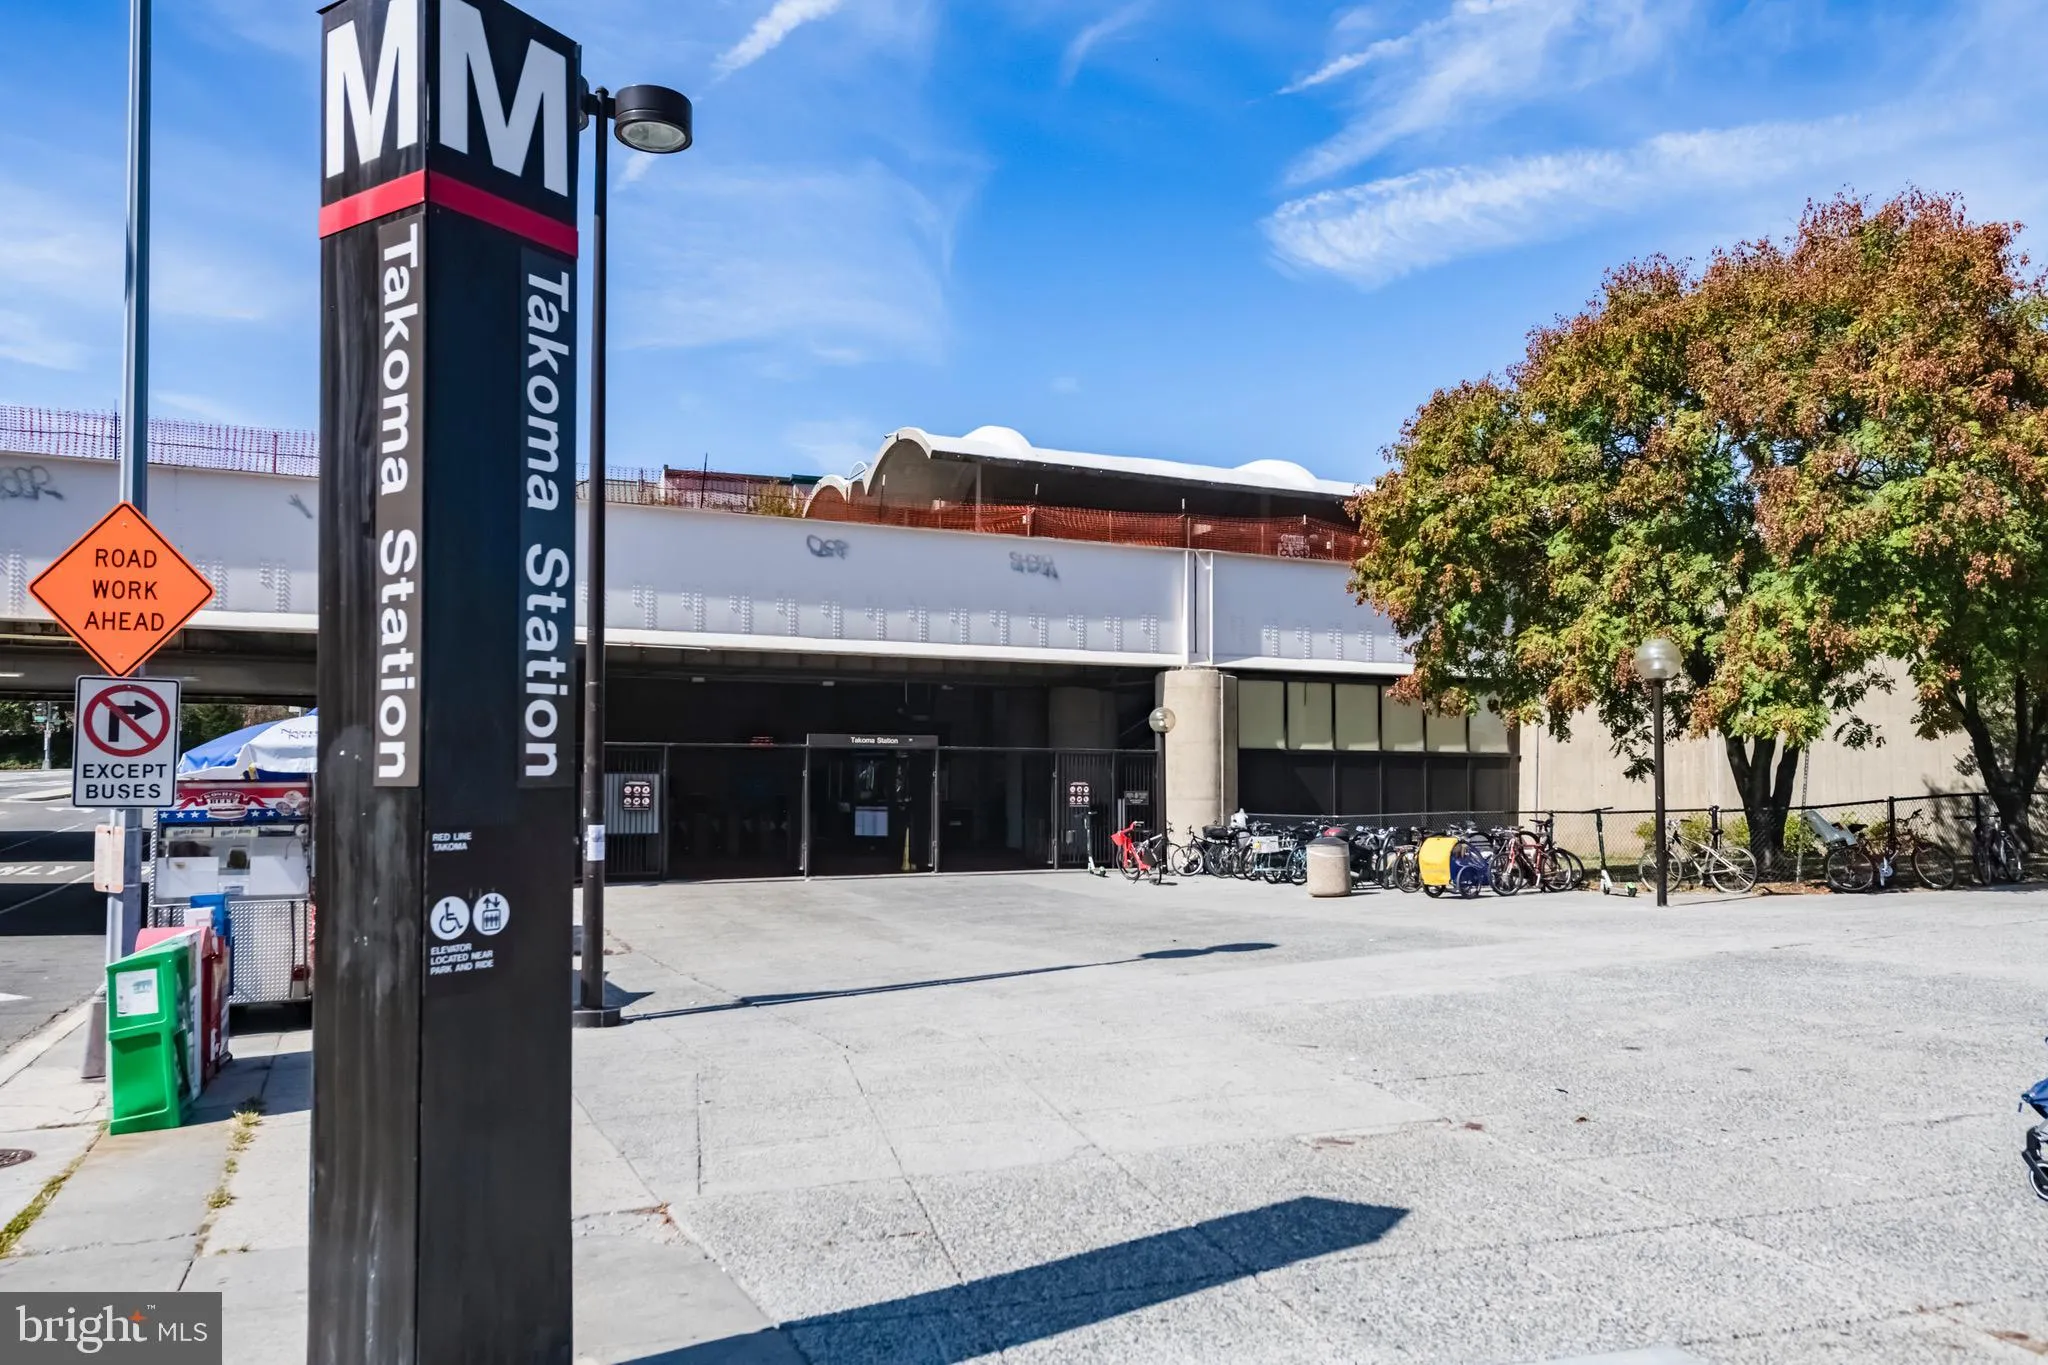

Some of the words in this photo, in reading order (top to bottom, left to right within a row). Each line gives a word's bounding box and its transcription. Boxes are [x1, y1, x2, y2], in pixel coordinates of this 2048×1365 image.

[326, 0, 418, 178] M
[440, 0, 568, 197] M
[381, 222, 418, 496] Takoma
[526, 271, 569, 511] Takoma
[95, 549, 157, 569] ROAD
[92, 579, 158, 600] WORK
[84, 611, 165, 632] AHEAD
[378, 529, 418, 779] Station
[524, 543, 570, 777] Station
[850, 736, 875, 744] Takoma
[82, 763, 167, 779] EXCEPT
[86, 783, 161, 799] BUSES
[432, 833, 451, 841] RED
[453, 832, 472, 841] LINE
[432, 842, 468, 851] TAKOMA
[430, 943, 472, 955] ELEVATOR
[430, 953, 469, 965] LOCATED
[471, 949, 494, 960] NEAR
[430, 965, 453, 976] PARK
[454, 962, 473, 972] AND
[474, 959, 495, 970] RIDE
